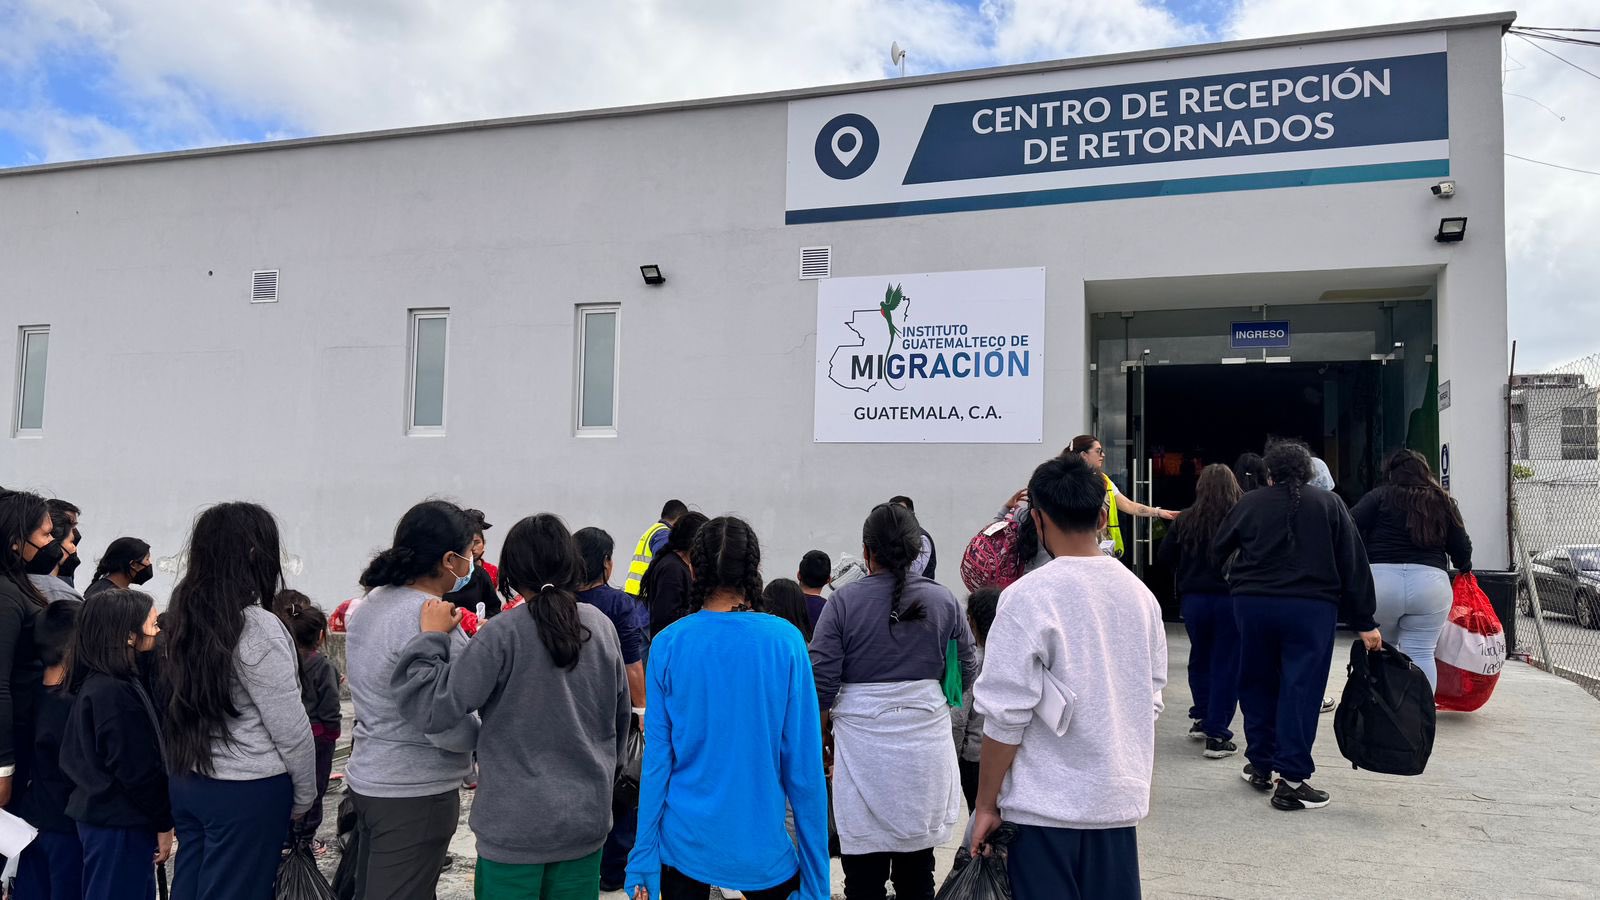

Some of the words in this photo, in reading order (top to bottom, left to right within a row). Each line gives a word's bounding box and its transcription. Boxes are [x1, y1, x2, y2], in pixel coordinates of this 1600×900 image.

[972, 98, 1111, 134] CENTRO
[1122, 91, 1168, 120] DE
[1179, 67, 1391, 115] RECEPCIÓN
[1024, 136, 1068, 165] DE
[1079, 112, 1335, 160] RETORNADOS
[902, 324, 968, 338] INSTITUTO
[1234, 329, 1285, 340] INGRESO
[902, 336, 1006, 350] GUATEMALTECO
[1010, 334, 1029, 347] DE
[851, 348, 1030, 381] MIGRACIÓN
[853, 406, 964, 422] GUATEMALA,
[968, 405, 1002, 420] C.A.
